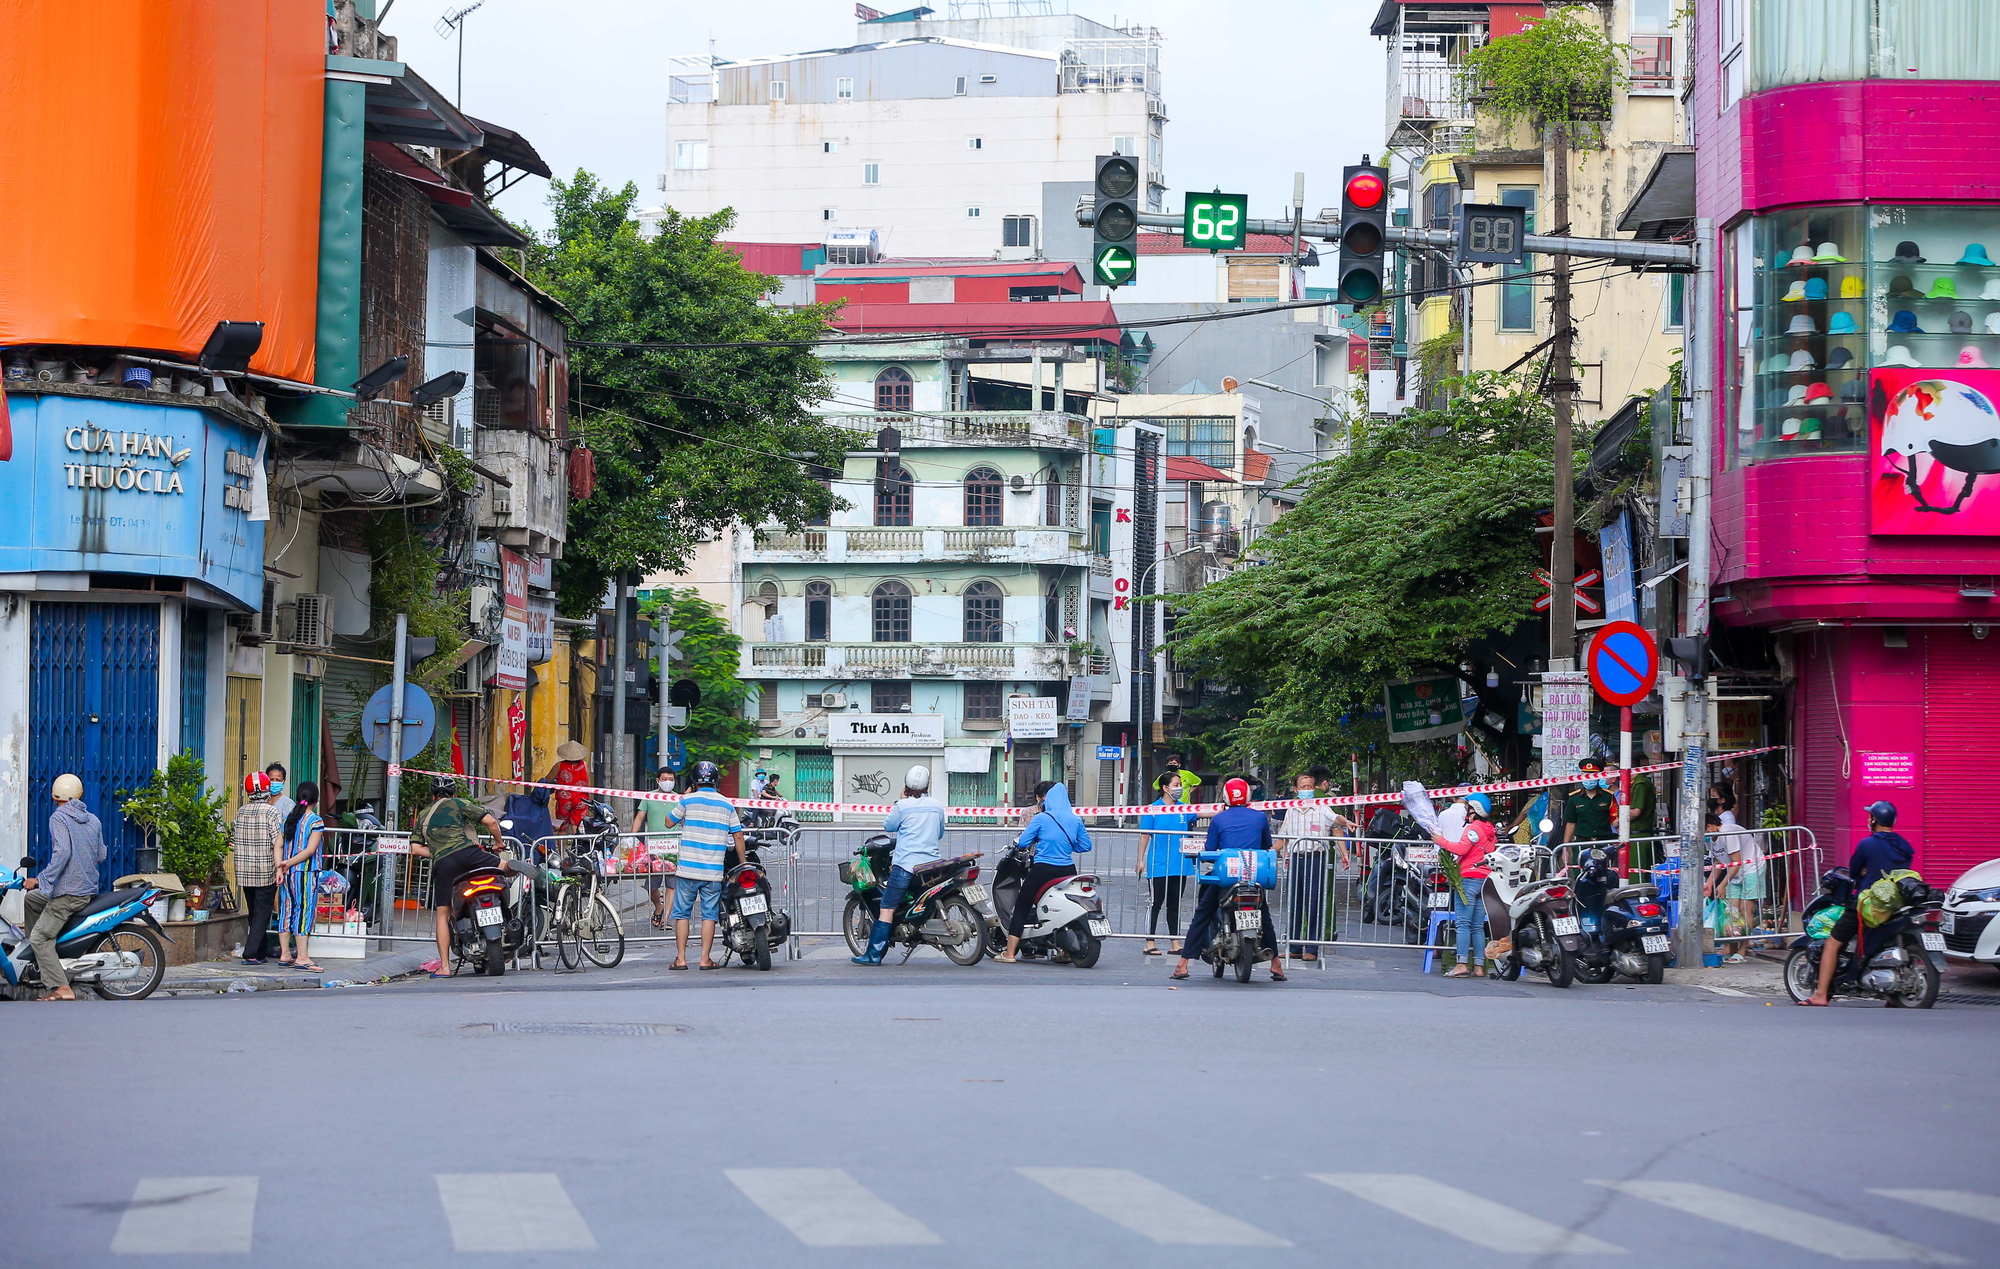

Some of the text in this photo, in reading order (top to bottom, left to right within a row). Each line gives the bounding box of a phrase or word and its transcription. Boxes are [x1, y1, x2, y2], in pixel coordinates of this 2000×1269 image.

[1192, 203, 1240, 241] 62
[1115, 508, 1131, 523] K
[1011, 697, 1055, 710] SINH TÀI
[850, 722, 910, 734] Thư Anh
